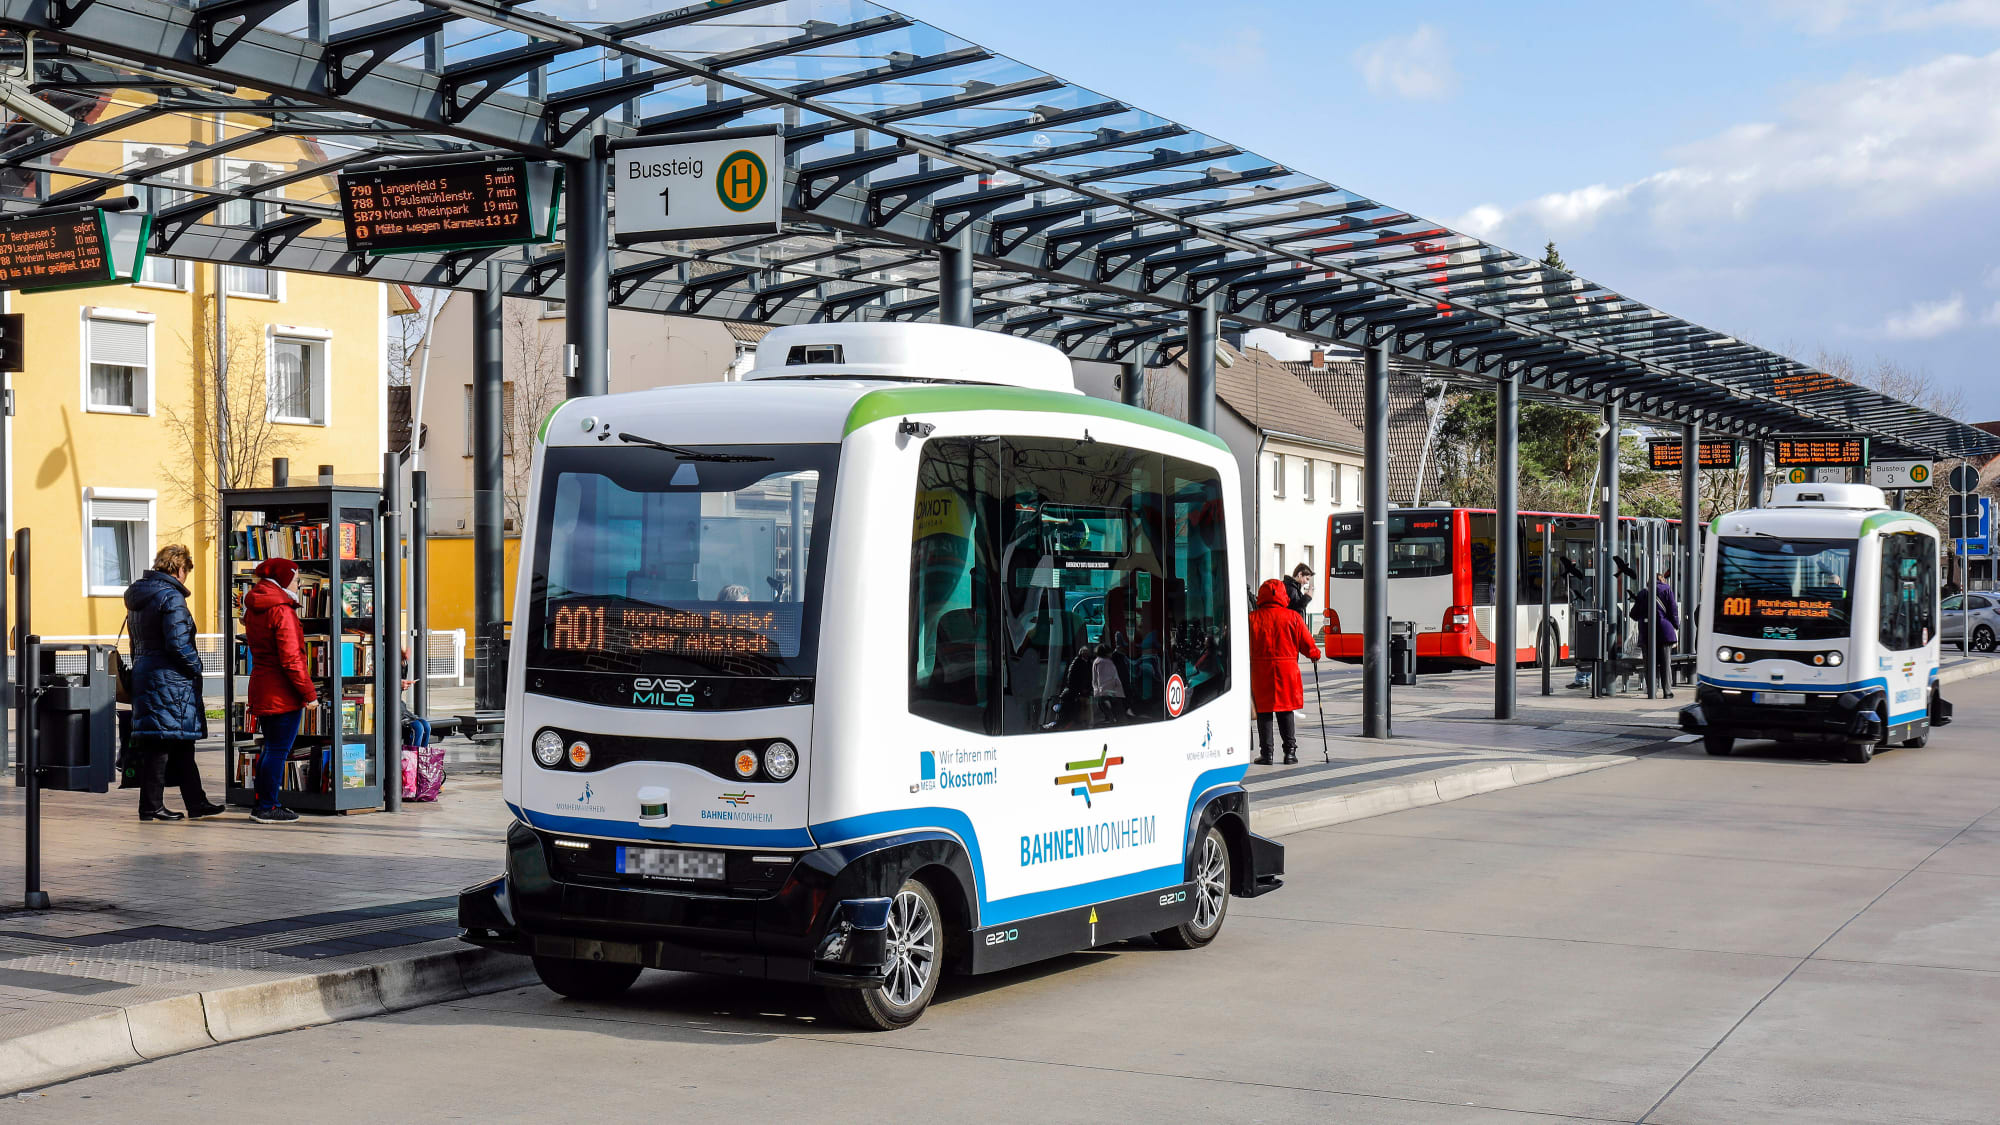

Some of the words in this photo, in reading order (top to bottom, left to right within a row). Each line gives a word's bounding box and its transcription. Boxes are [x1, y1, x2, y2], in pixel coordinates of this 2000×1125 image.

[629, 156, 703, 179] Bussteig
[351, 186, 372, 196] 790
[380, 180, 436, 196] Langenfeld
[440, 179, 447, 190] S
[484, 174, 492, 185] 5
[494, 174, 514, 185] min
[732, 164, 752, 198] H
[352, 199, 374, 209] 788
[382, 197, 391, 207] D.
[394, 192, 474, 206] Paulsmühlenstr.
[486, 188, 493, 198] 7
[496, 187, 516, 198] min
[659, 187, 668, 216] 1
[354, 210, 382, 222] SB79
[384, 209, 413, 220] Monh.
[417, 203, 470, 218] Rheinpark
[483, 201, 496, 212] 19
[498, 200, 518, 211] min
[11, 230, 50, 242] Berghausen
[50, 226, 56, 236] S
[73, 222, 96, 234] sofort
[406, 221, 440, 234] wegen
[14, 240, 48, 254] Langenfeld
[50, 239, 55, 248] S
[75, 236, 83, 245] 10
[85, 234, 98, 243] min
[0, 256, 10, 266] 88
[15, 253, 44, 264] Monheim
[46, 250, 75, 260] Heerweg
[78, 247, 85, 256] 11
[87, 245, 100, 255] min
[23, 266, 31, 276] 14
[1888, 474, 1894, 483] 3
[1723, 597, 1751, 616] A01
[554, 606, 605, 649] A01
[623, 609, 704, 628] Monheim
[710, 611, 778, 630] Busbf.
[685, 632, 768, 651] Altstadt
[1171, 686, 1180, 705] 20
[939, 750, 953, 764] Wir
[956, 748, 981, 763] fahren
[984, 747, 997, 760] mit
[921, 781, 936, 790] MEGA
[940, 767, 997, 789] Ökostrom!
